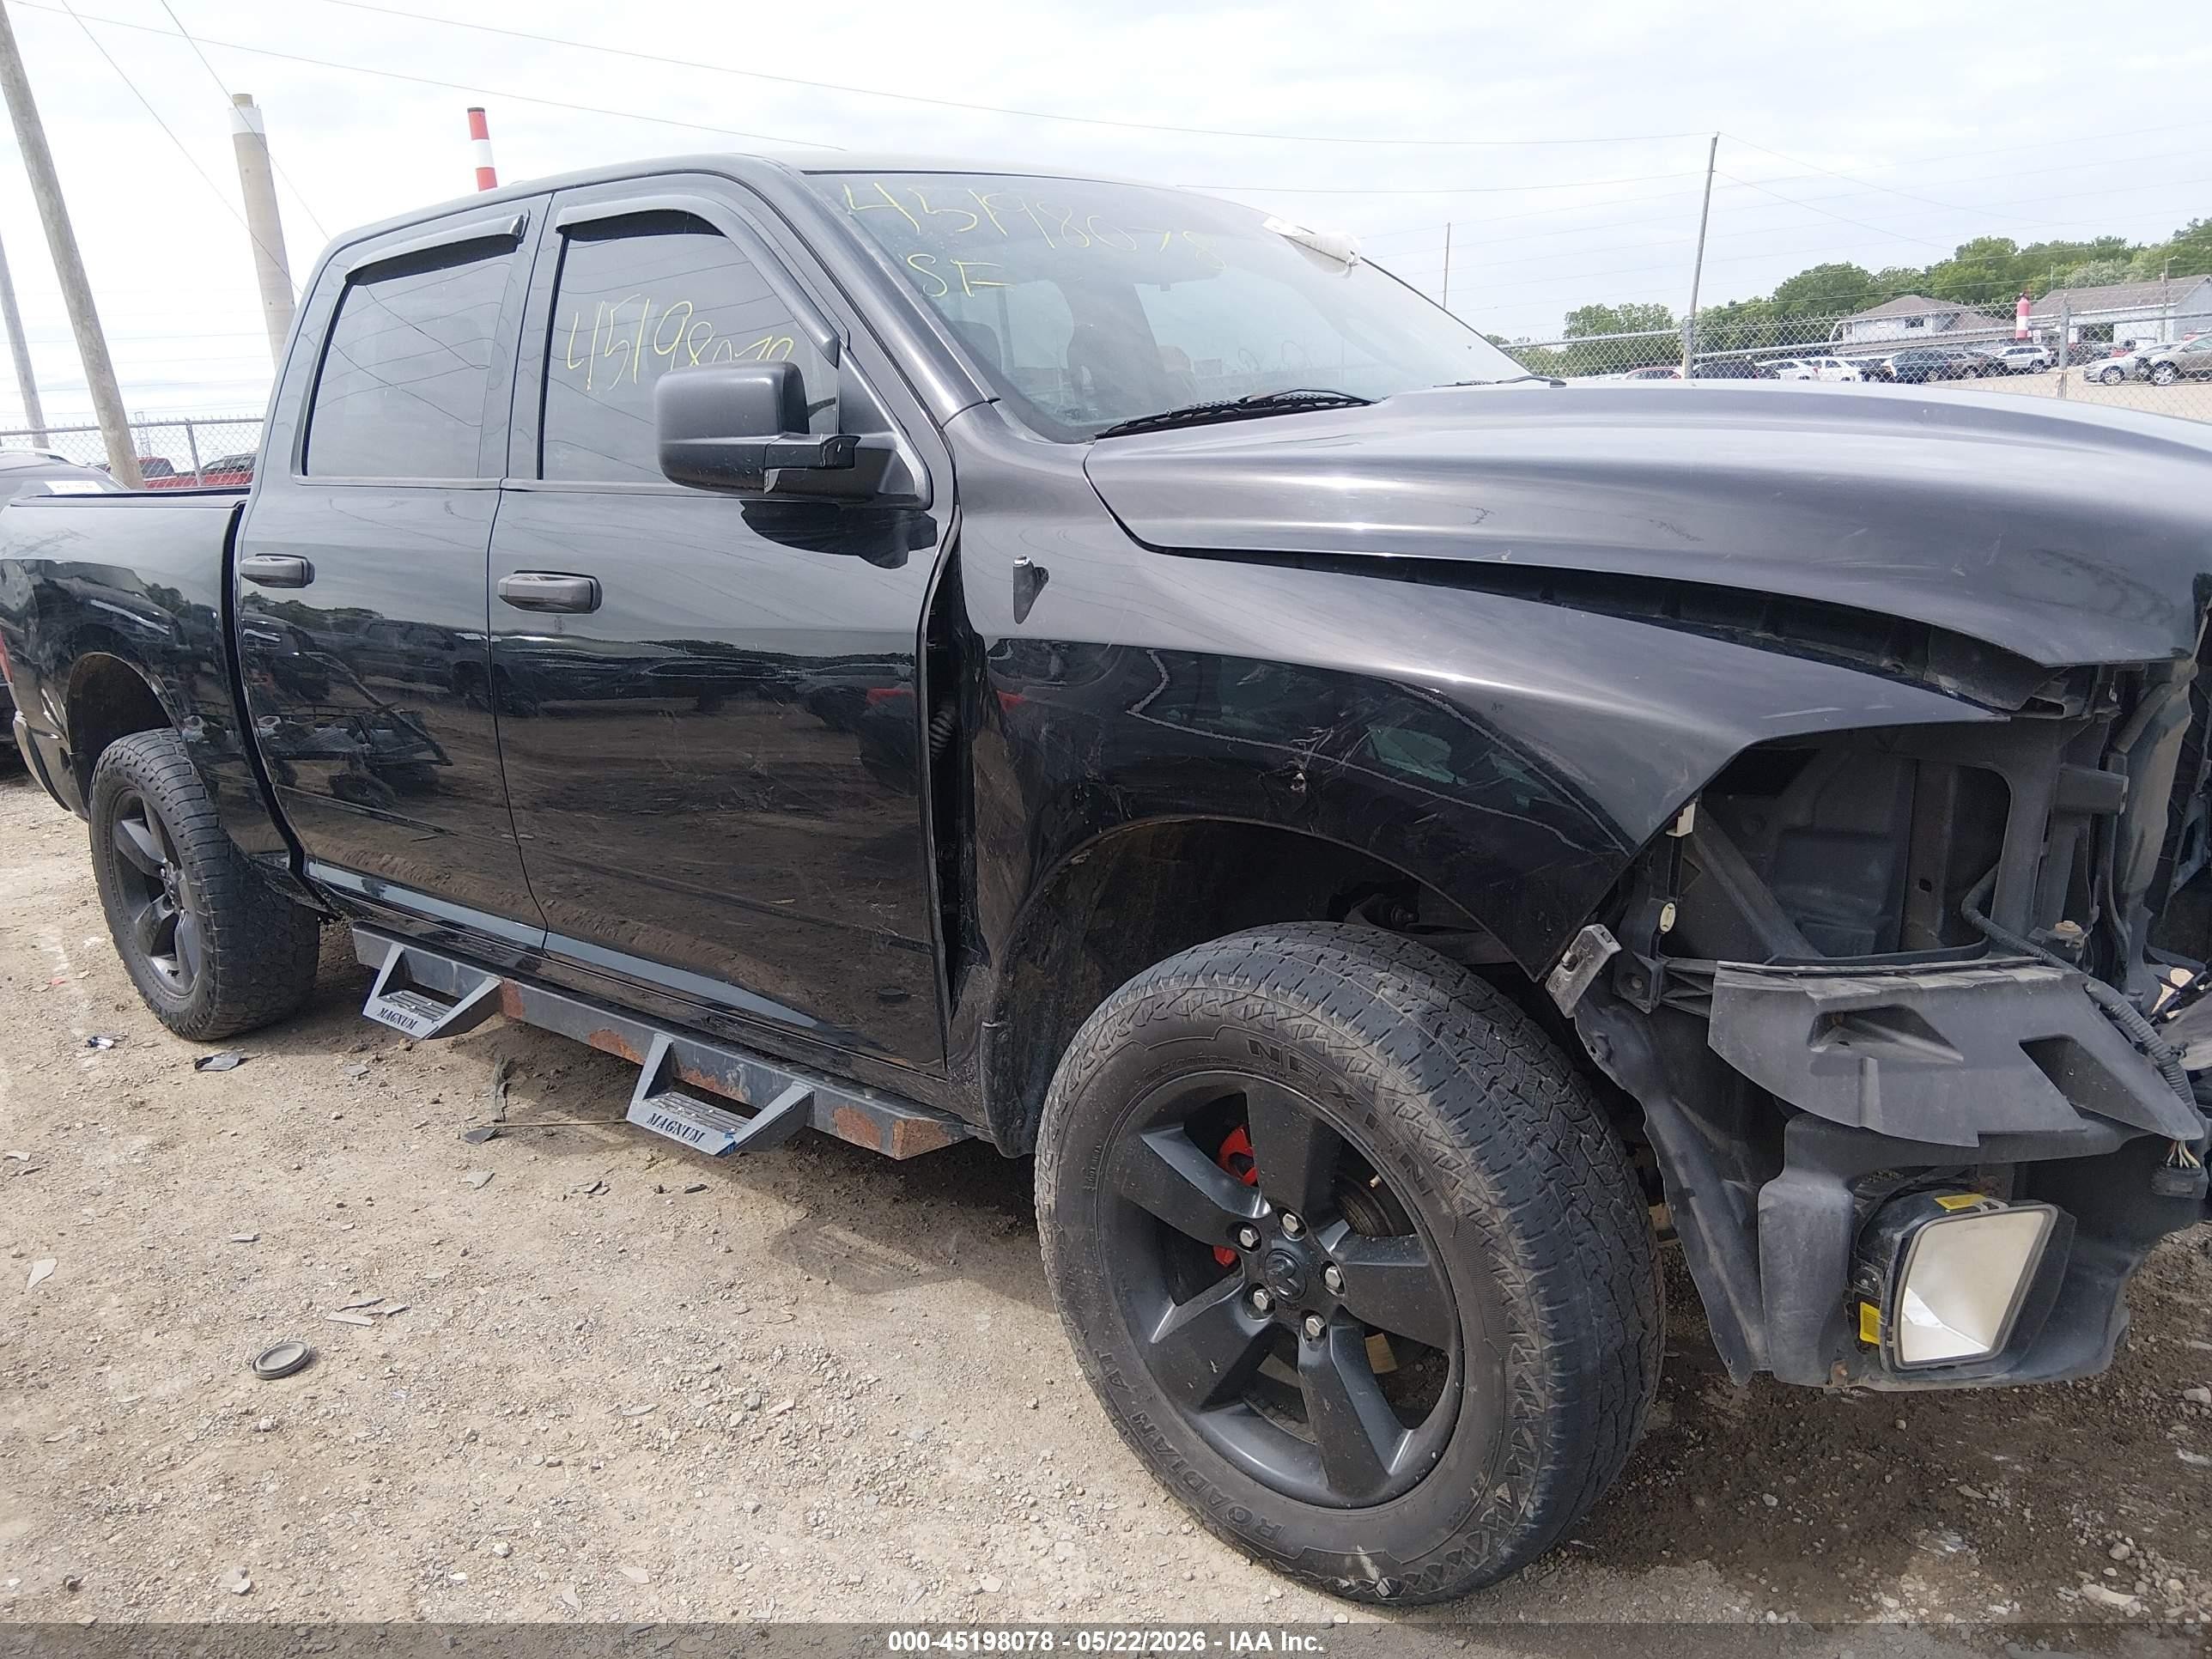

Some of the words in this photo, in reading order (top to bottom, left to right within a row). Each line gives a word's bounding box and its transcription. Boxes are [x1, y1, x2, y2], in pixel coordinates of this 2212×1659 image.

[378, 1007, 419, 1030] MAGNUM
[646, 1112, 707, 1144] MAGNUM
[1130, 1412, 1285, 1541] ROADIAN
